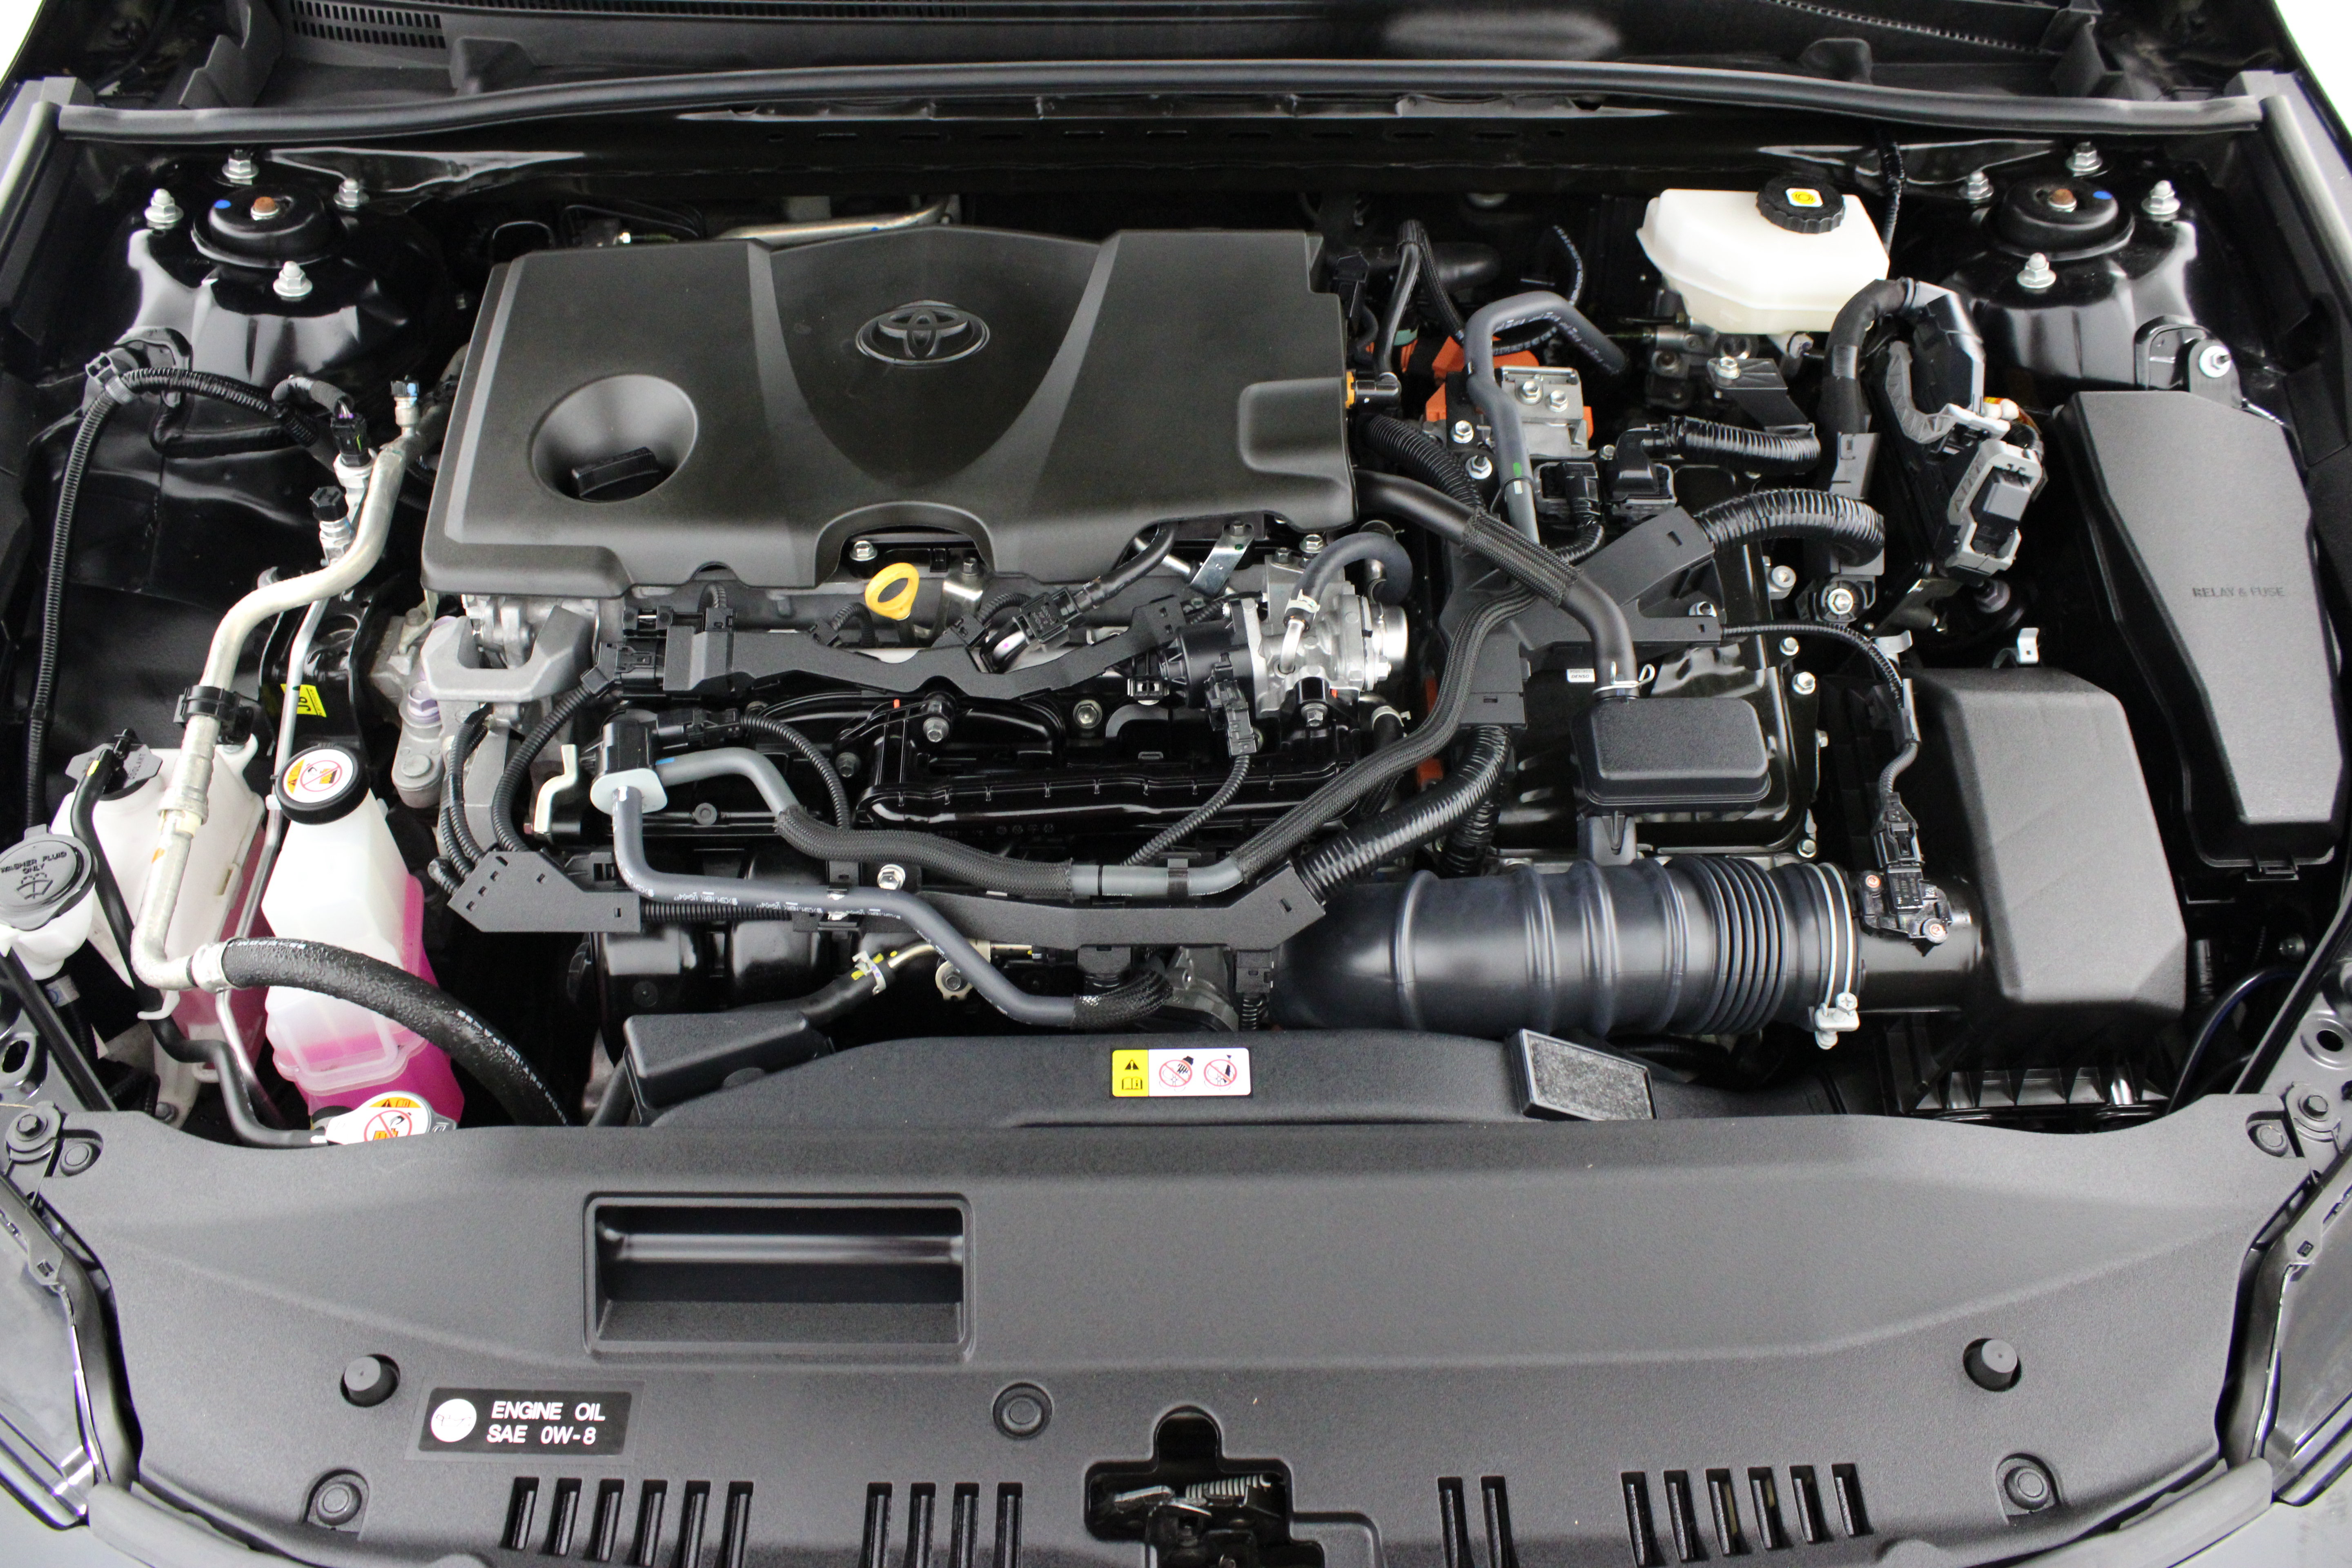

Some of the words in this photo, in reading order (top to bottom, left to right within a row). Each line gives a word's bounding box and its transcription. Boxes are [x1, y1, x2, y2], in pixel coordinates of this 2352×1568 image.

[2192, 587, 2234, 597] RELAY
[2250, 587, 2286, 597] FUSE
[0, 859, 37, 873] WASHER
[22, 863, 45, 874] ONLY
[491, 1401, 564, 1420] ENGINE
[575, 1403, 606, 1421] OIL
[487, 1424, 528, 1444] SAE
[541, 1426, 597, 1446] 0W-8
